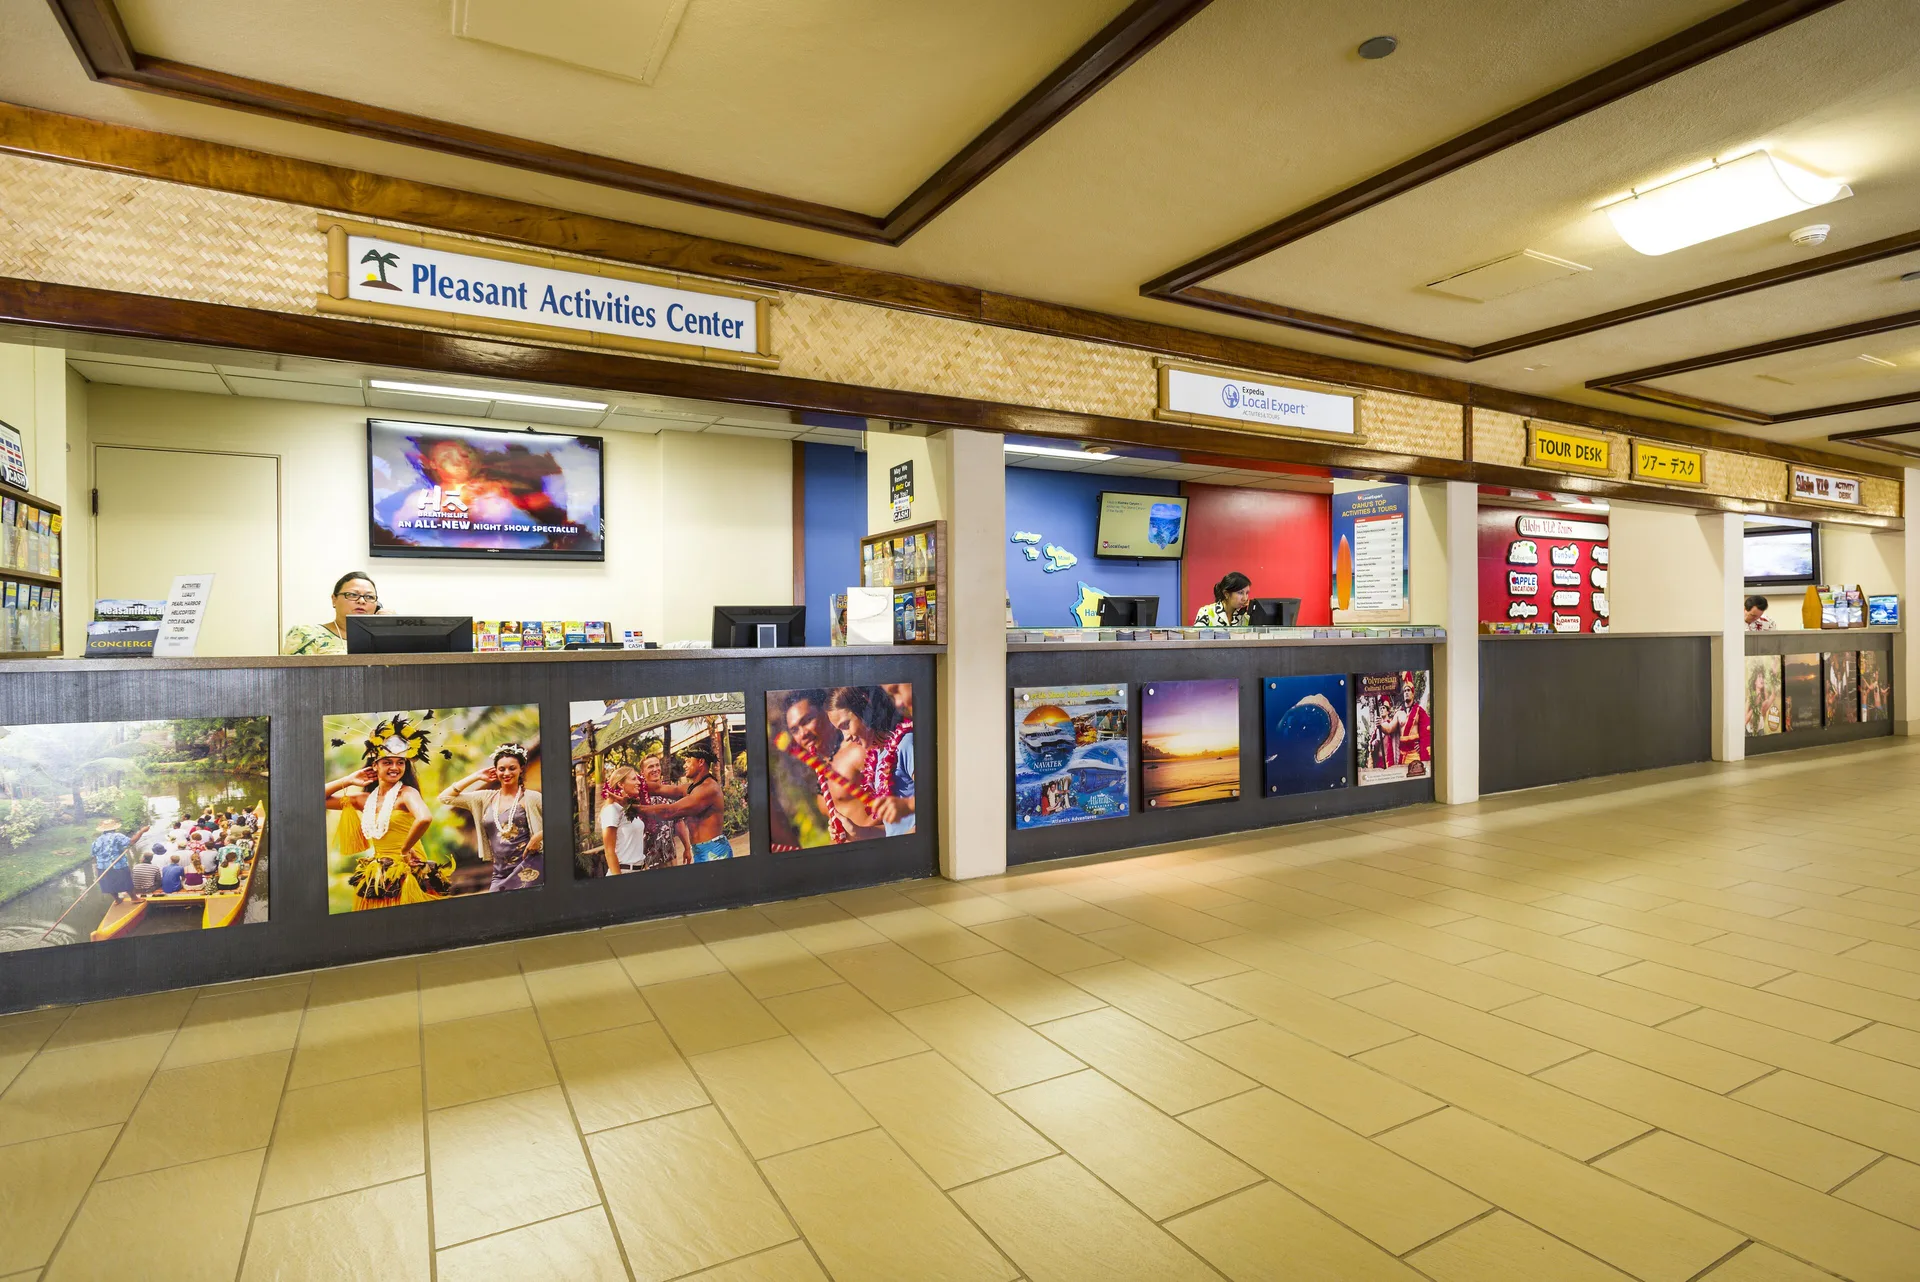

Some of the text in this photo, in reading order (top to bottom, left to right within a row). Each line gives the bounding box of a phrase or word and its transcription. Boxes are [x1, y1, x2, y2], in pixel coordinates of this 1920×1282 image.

[412, 263, 744, 339] Pleasant Activities Center
[1242, 386, 1265, 396] Expedia
[1242, 395, 1306, 415] Local Expert
[1538, 438, 1602, 462] TOUR DESK
[1642, 454, 1695, 476] ツアー デスク
[1834, 481, 1856, 491] ACTIVITY
[1838, 491, 1852, 500] DESK
[1342, 507, 1370, 517] ACTIVITIES
[1377, 504, 1398, 513] TOURS
[398, 520, 578, 534] AN ALL-NEW NIGHT SHOW SPECTACLE!
[1514, 575, 1536, 586] APPLE
[1511, 585, 1536, 593] VACATIONS
[397, 619, 427, 627] DELL
[90, 640, 153, 648] CONCIERGE
[1364, 675, 1397, 686] Polynesian
[1033, 761, 1063, 769] NAVATEK
